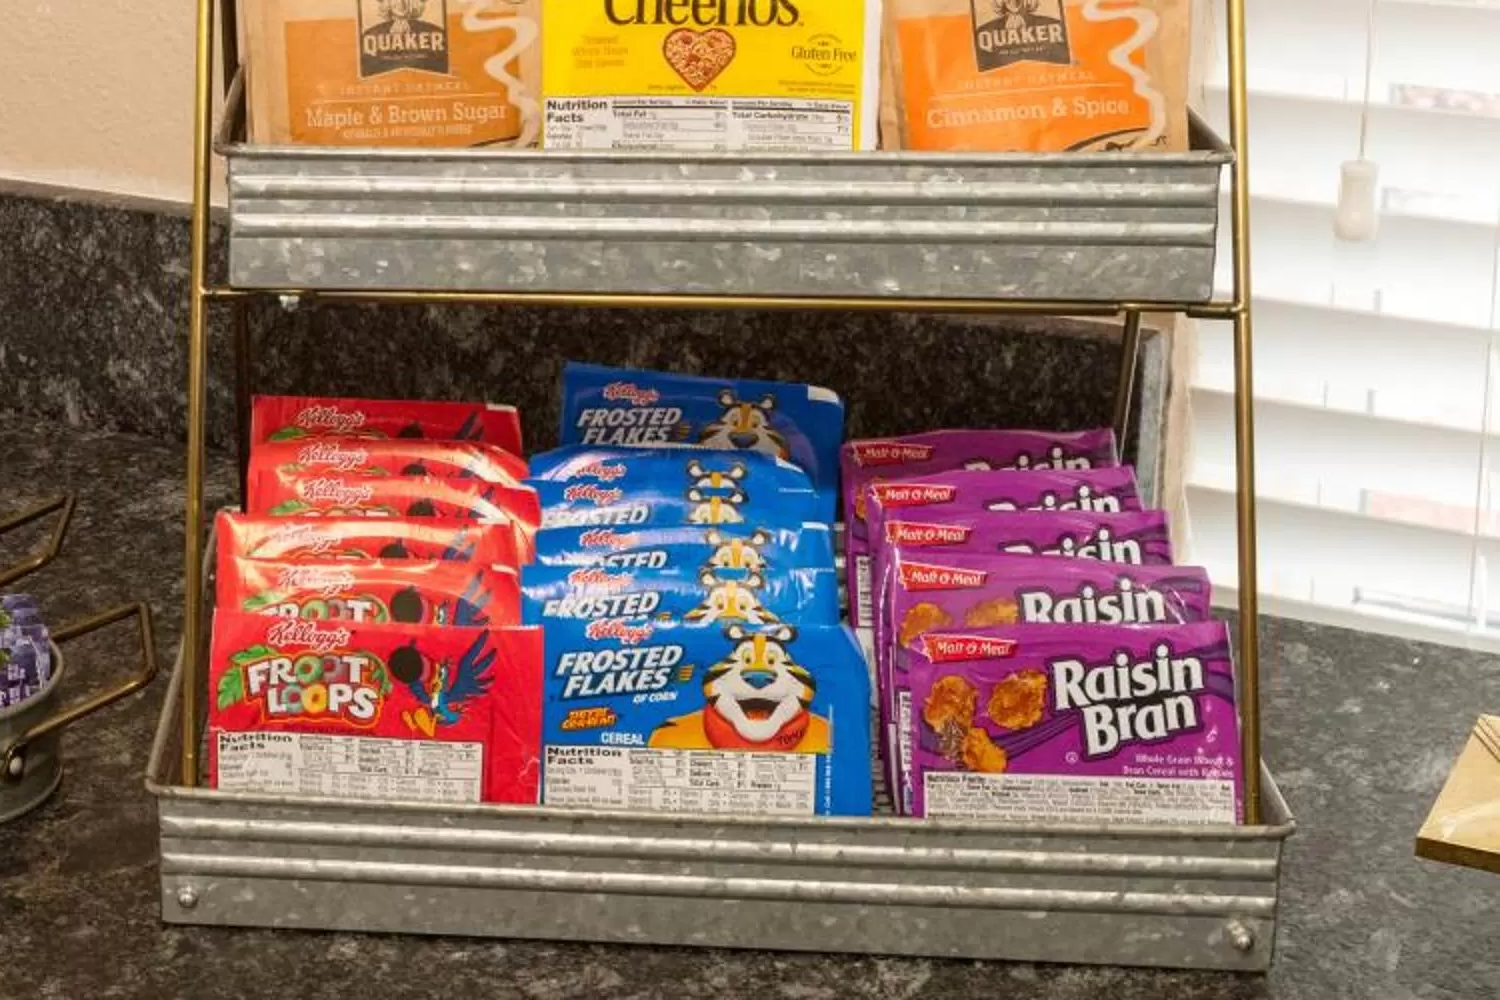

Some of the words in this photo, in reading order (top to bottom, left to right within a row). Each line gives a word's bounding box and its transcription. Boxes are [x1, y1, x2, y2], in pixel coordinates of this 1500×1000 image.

[363, 31, 445, 57] QUAKER
[978, 24, 1064, 51] QUAKER
[791, 45, 832, 61] Gluten
[306, 107, 364, 129] Maple
[370, 105, 383, 124] &
[388, 105, 447, 124] Brown
[454, 103, 506, 124] Sugar
[547, 100, 608, 111] Nutrition
[547, 112, 584, 123] Facts
[926, 105, 1045, 130] Cinnamon
[1051, 97, 1068, 117] &
[1073, 96, 1131, 119] Spice
[576, 407, 682, 428] FROSTED
[582, 425, 672, 444] FLAKES
[543, 591, 660, 619] FROSTED
[1020, 578, 1167, 625] Raisin
[268, 620, 350, 651] Kellogg's
[556, 645, 683, 676] FROSTED
[248, 655, 369, 695] FROOT
[563, 668, 671, 698] FLAKES
[1051, 643, 1204, 711] Raisin
[268, 683, 378, 718] LOOPS
[601, 732, 645, 745] CEREAL
[1082, 695, 1197, 757] Bran
[547, 747, 622, 757] Nutrition
[547, 757, 594, 765] Facts
[1124, 765, 1144, 775] Bran
